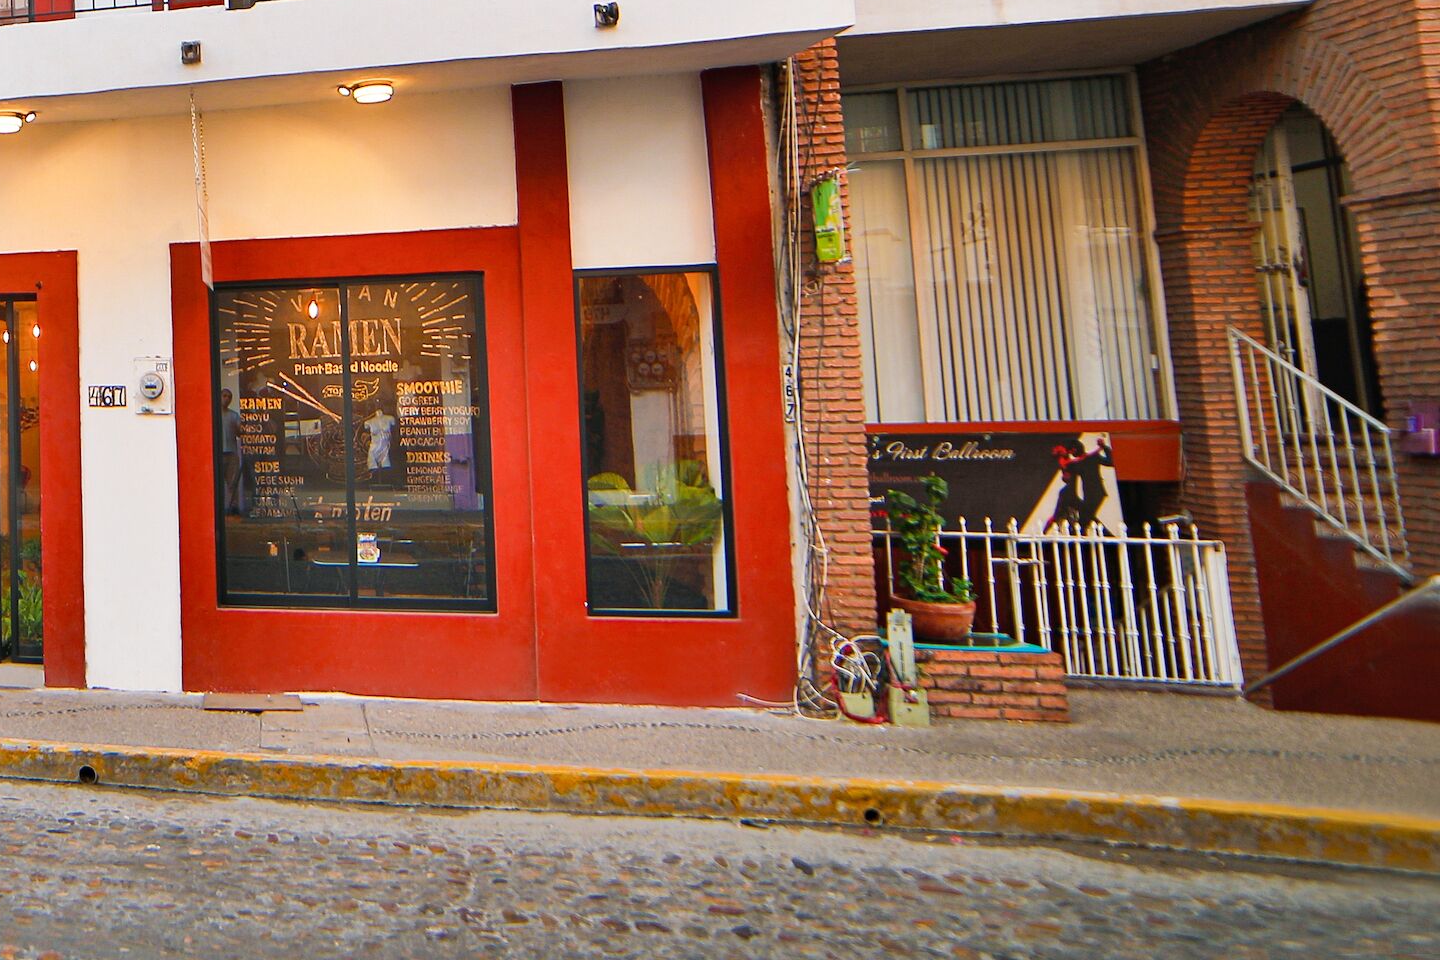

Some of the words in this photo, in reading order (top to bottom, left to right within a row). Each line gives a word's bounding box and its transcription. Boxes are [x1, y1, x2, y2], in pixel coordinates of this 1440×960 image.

[291, 285, 398, 312] VEAN
[287, 317, 402, 359] RAMEN
[294, 363, 358, 375] Plant-Basd
[361, 360, 399, 373] Noodle
[396, 380, 463, 395] SMOOTHIE
[89, 386, 125, 406] 467
[412, 396, 439, 405] GREEN
[240, 397, 282, 410] RAMEN
[399, 407, 419, 416] VERY
[421, 406, 446, 416] BERRY
[240, 413, 269, 422] SHOYU
[400, 417, 452, 426] STRAWBERRY
[406, 451, 452, 463] DRINKS
[886, 441, 929, 461] First
[931, 441, 1015, 461] Ballroom
[254, 461, 280, 473] SIDE
[278, 476, 304, 484] SUSHI
